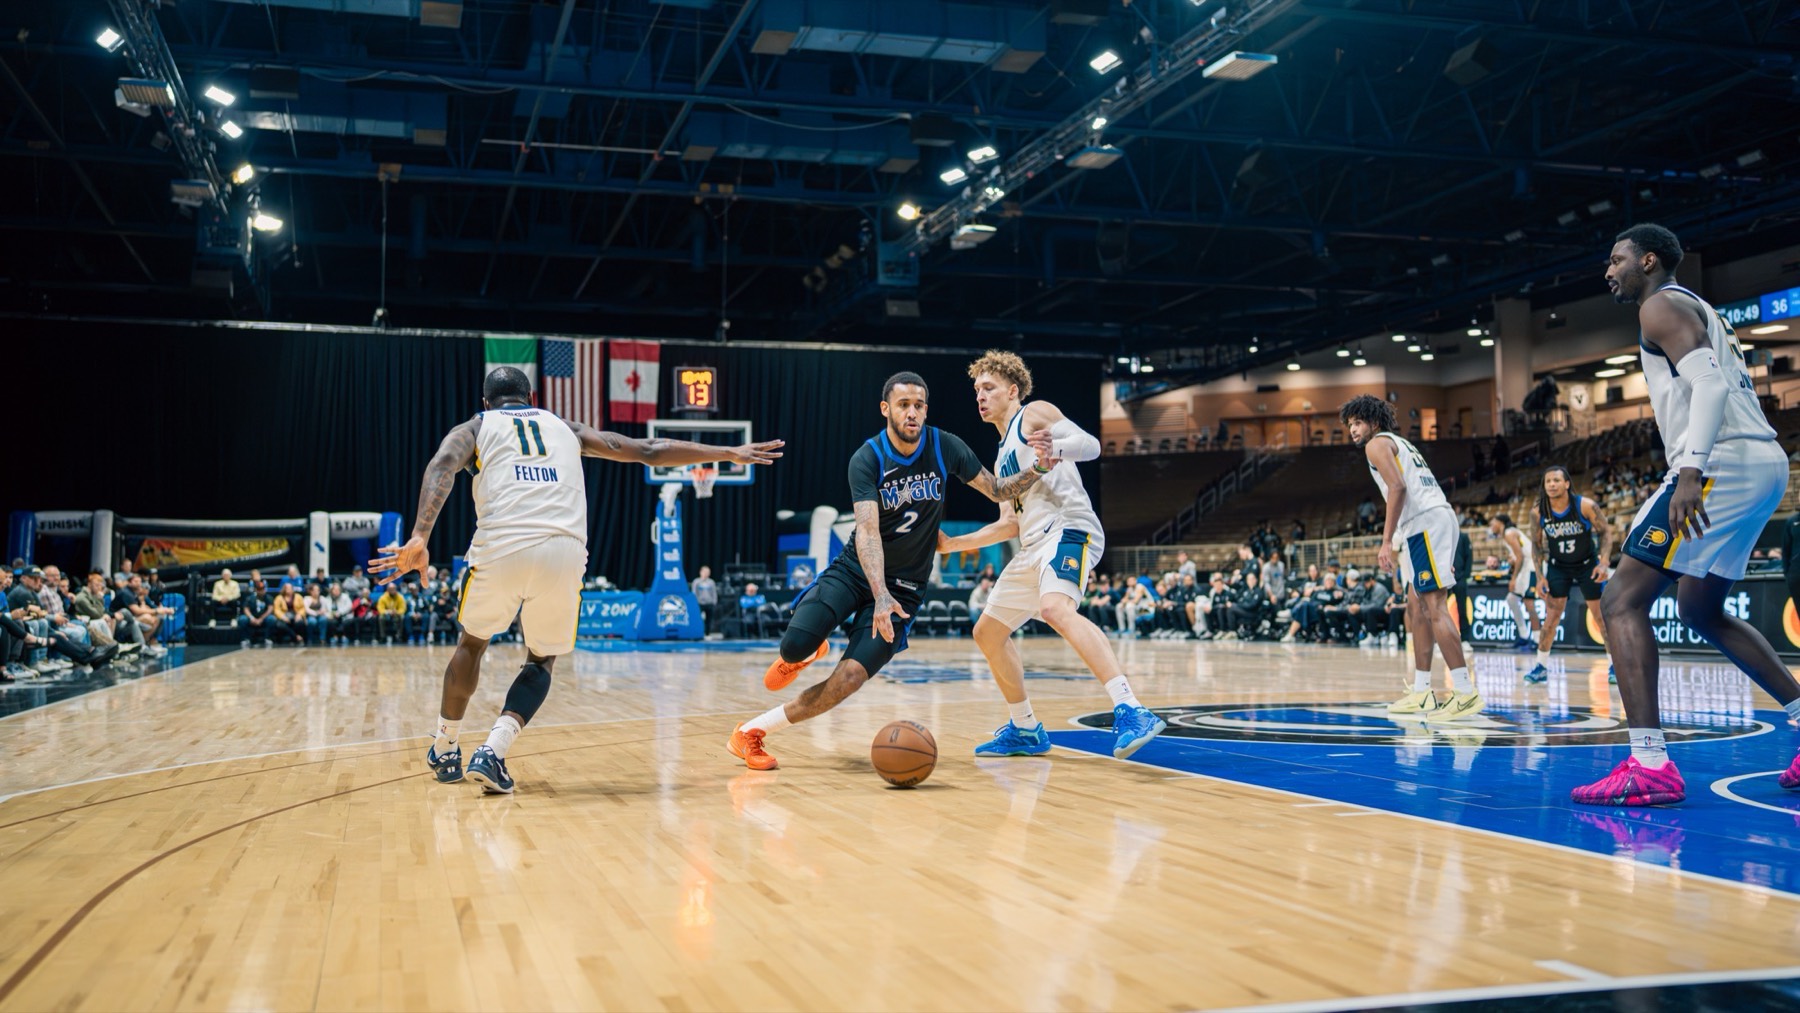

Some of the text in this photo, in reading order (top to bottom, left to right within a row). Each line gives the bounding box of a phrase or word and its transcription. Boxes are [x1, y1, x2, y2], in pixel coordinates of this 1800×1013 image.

[1726, 304, 1760, 324] 10:49
[1772, 298, 1788, 315] 36
[689, 384, 709, 406] 13
[513, 418, 547, 456] 11
[514, 465, 558, 482] FELTON
[883, 471, 937, 488] OSCEOLA
[879, 477, 942, 511] MAGIC
[39, 520, 85, 530] FINISH
[335, 520, 376, 531] START
[895, 511, 919, 533] 2
[1558, 539, 1576, 554] 13
[1472, 620, 1517, 640] Credit
